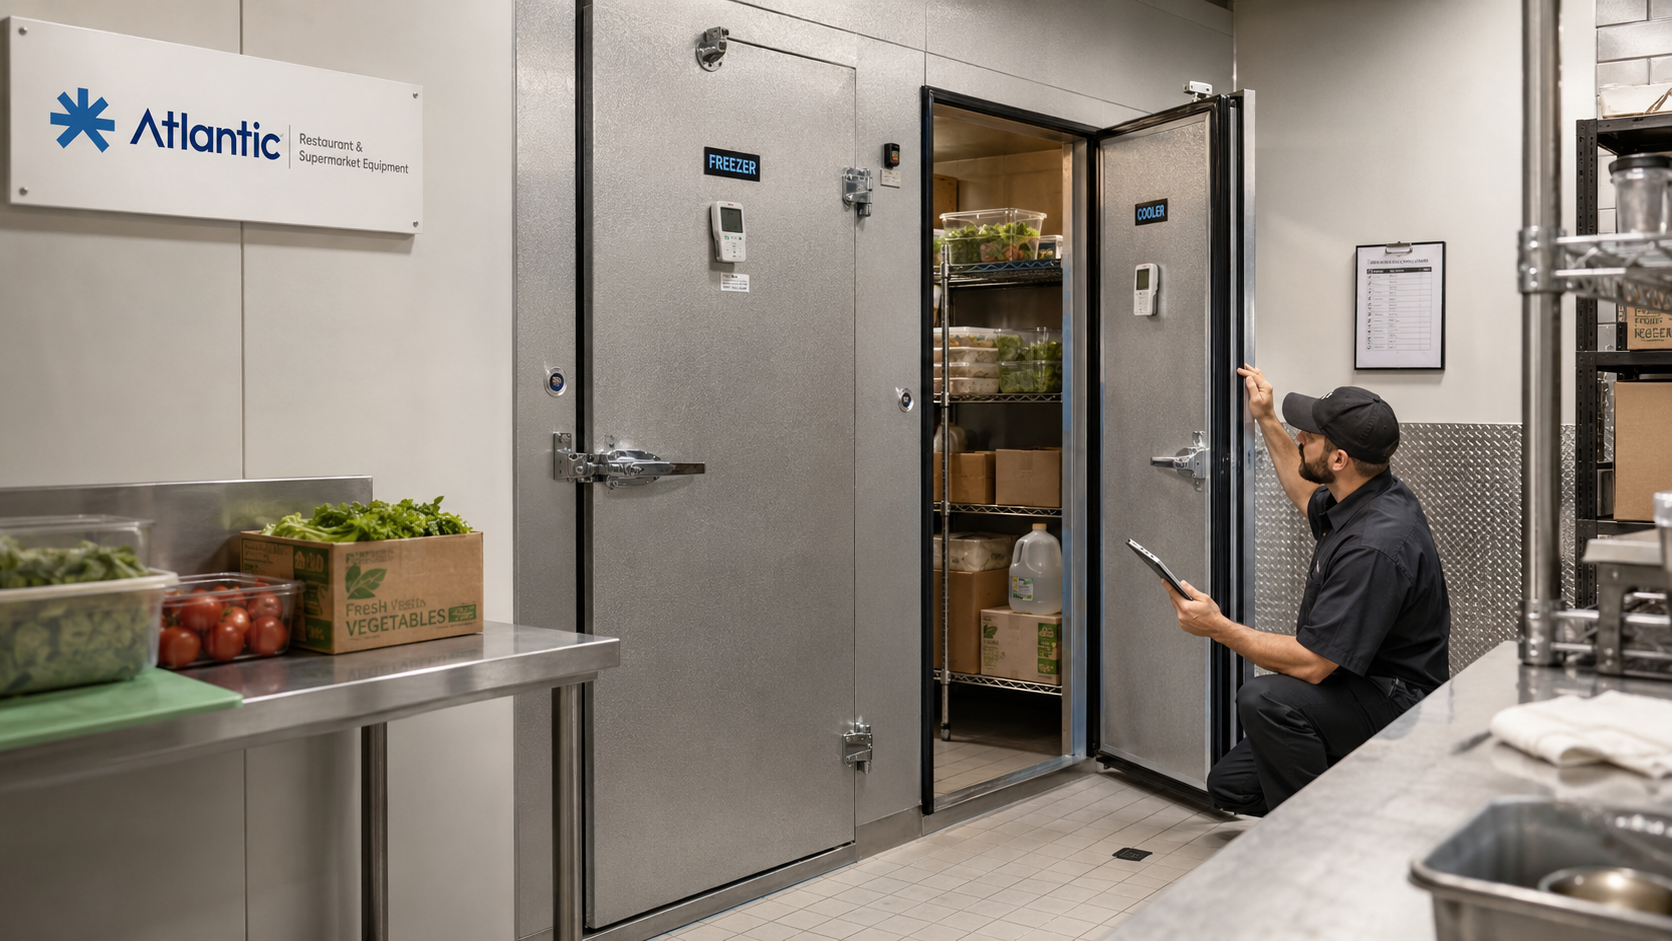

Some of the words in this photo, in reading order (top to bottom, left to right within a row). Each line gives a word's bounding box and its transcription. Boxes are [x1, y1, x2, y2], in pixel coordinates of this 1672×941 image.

[130, 108, 281, 160] Atlantic
[299, 133, 354, 151] Restaurant
[355, 141, 363, 152] &
[299, 150, 361, 168] Supermarket
[363, 158, 409, 174] Equipment
[709, 154, 756, 175] FREEZER
[1137, 204, 1165, 220] COOLER
[346, 608, 446, 636] VEGETABLES
